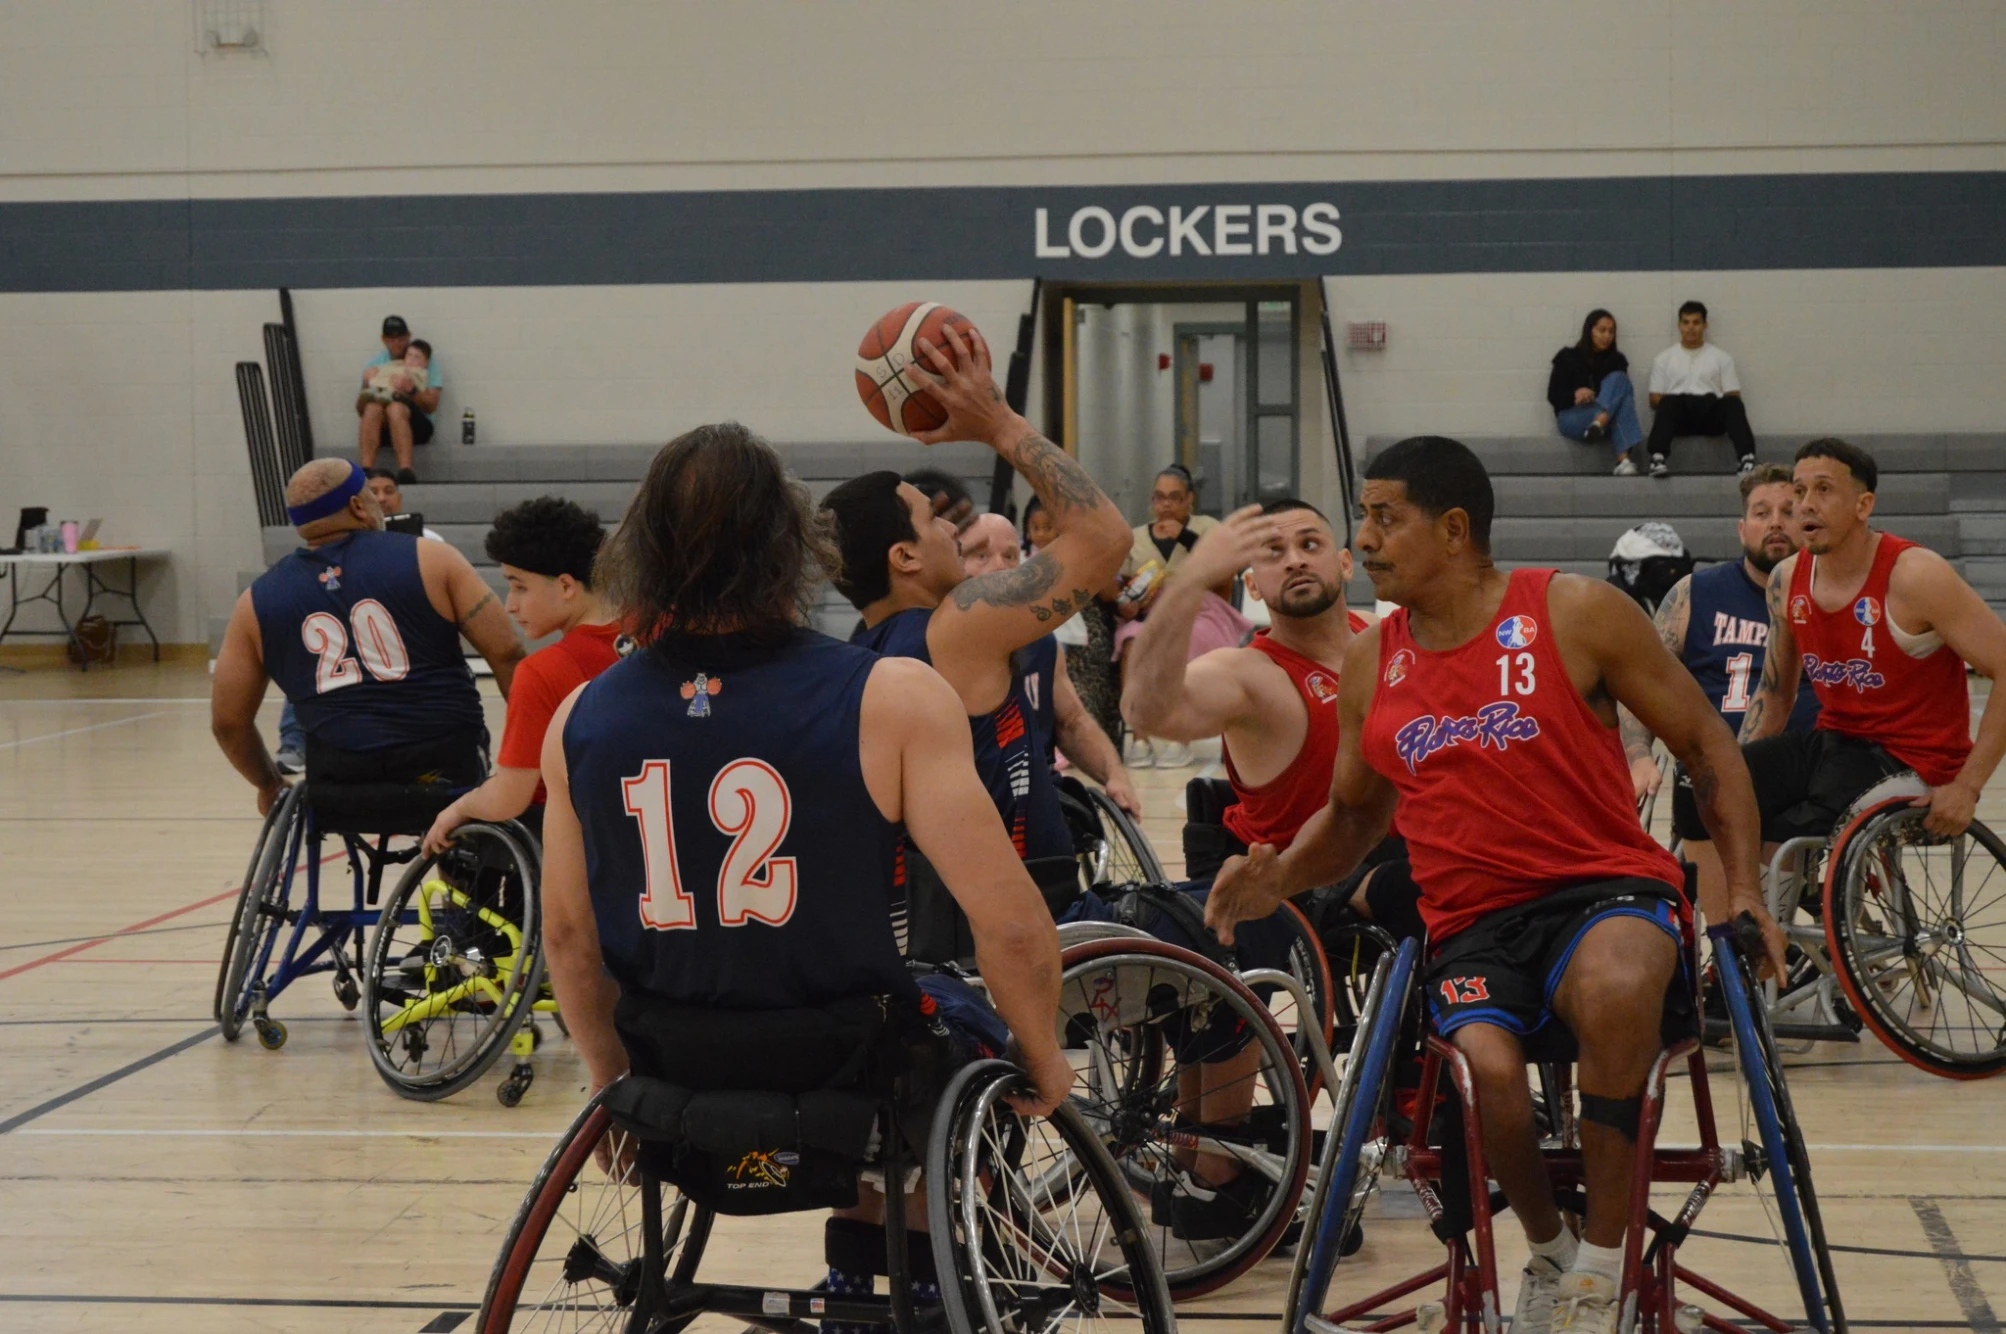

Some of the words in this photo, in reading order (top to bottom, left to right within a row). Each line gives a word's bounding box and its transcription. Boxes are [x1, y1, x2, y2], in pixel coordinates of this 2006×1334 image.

[1035, 202, 1342, 258] LOCKERS
[302, 598, 410, 695] 20
[1713, 611, 1769, 647] TAMP
[1861, 626, 1876, 658] 4
[1496, 652, 1536, 696] 13
[1721, 652, 1753, 712] 1
[620, 757, 798, 931] 12
[1440, 976, 1490, 1005] 13
